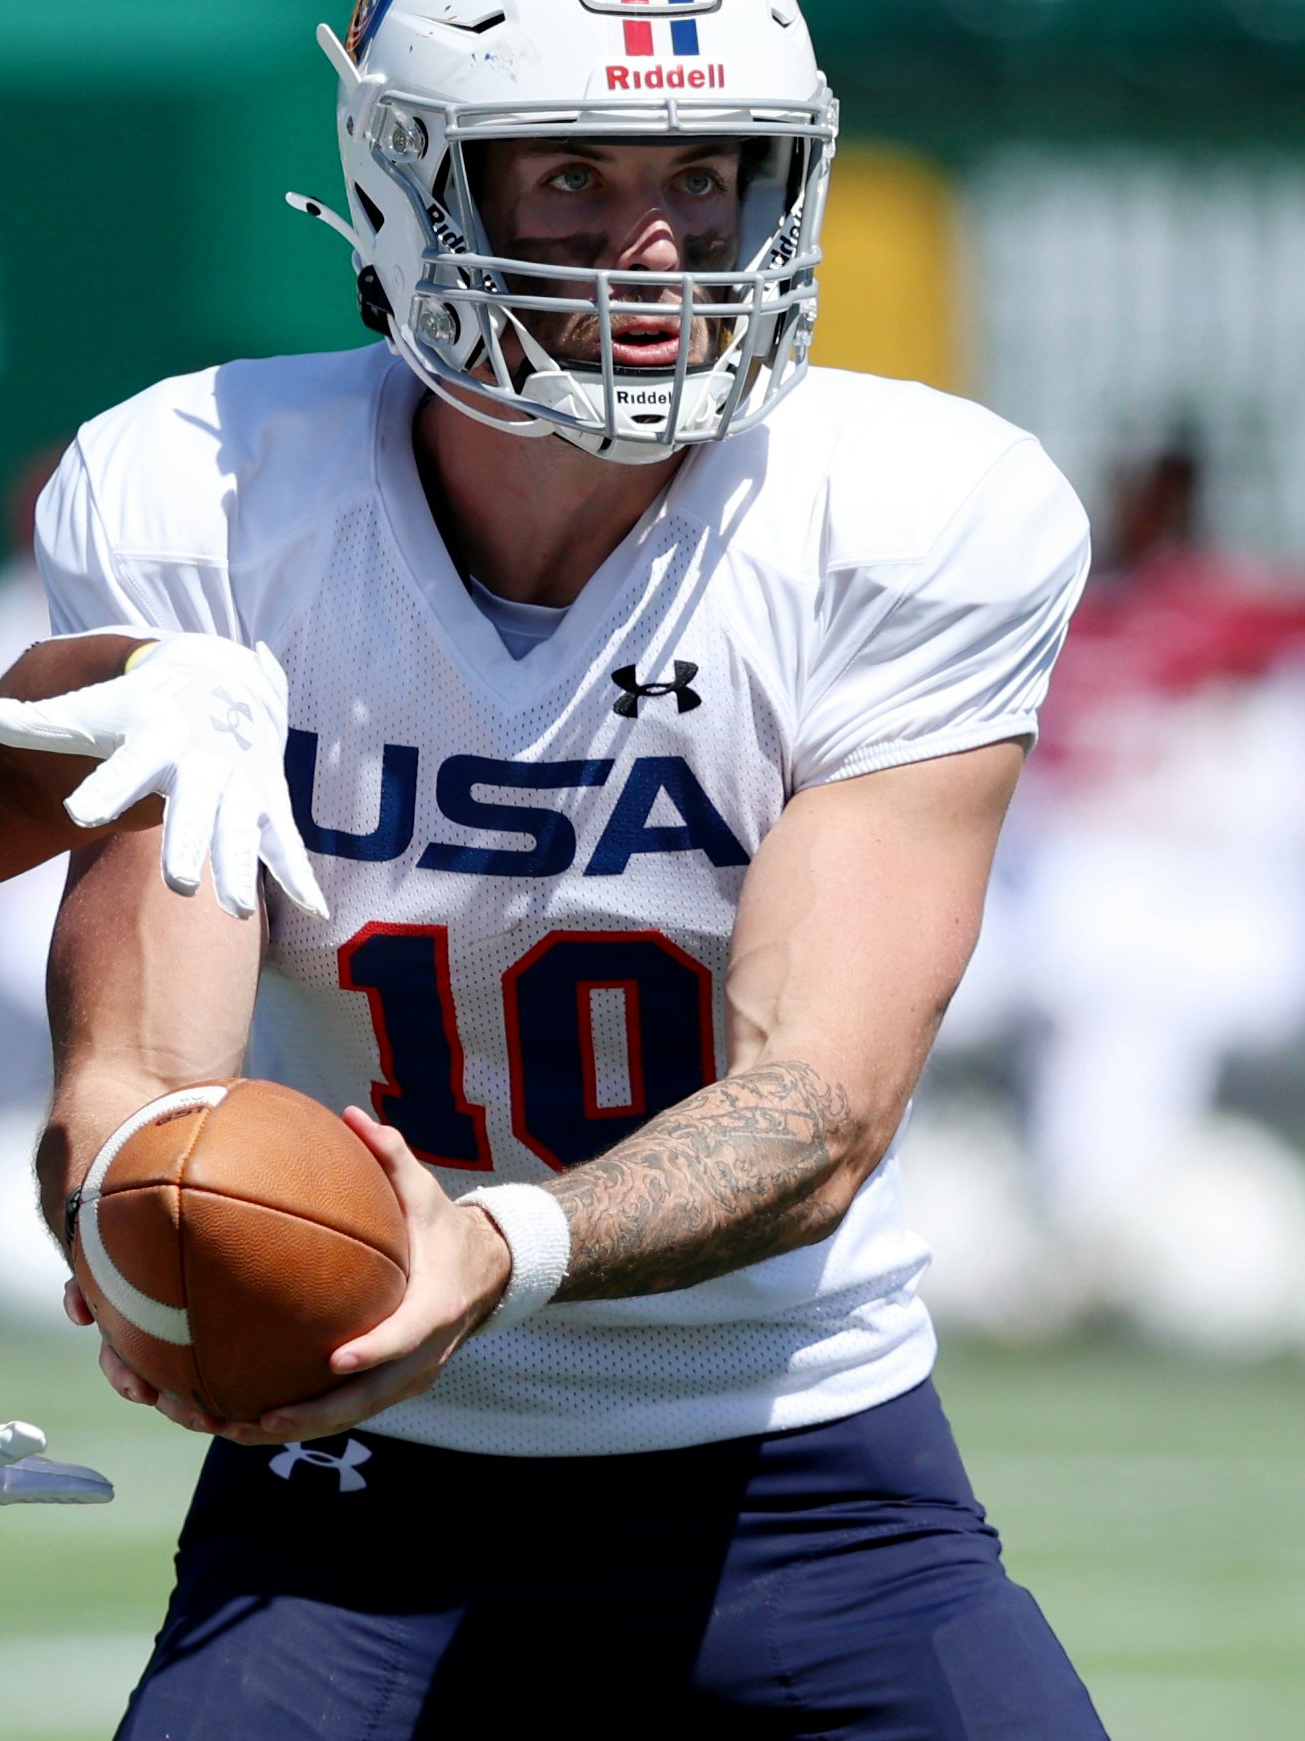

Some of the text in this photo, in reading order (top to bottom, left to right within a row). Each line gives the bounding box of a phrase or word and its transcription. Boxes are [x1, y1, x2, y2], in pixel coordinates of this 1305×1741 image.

[605, 63, 725, 91] Riddell
[616, 390, 673, 404] Riddel
[284, 727, 752, 879] USA
[337, 919, 718, 1174] 10
